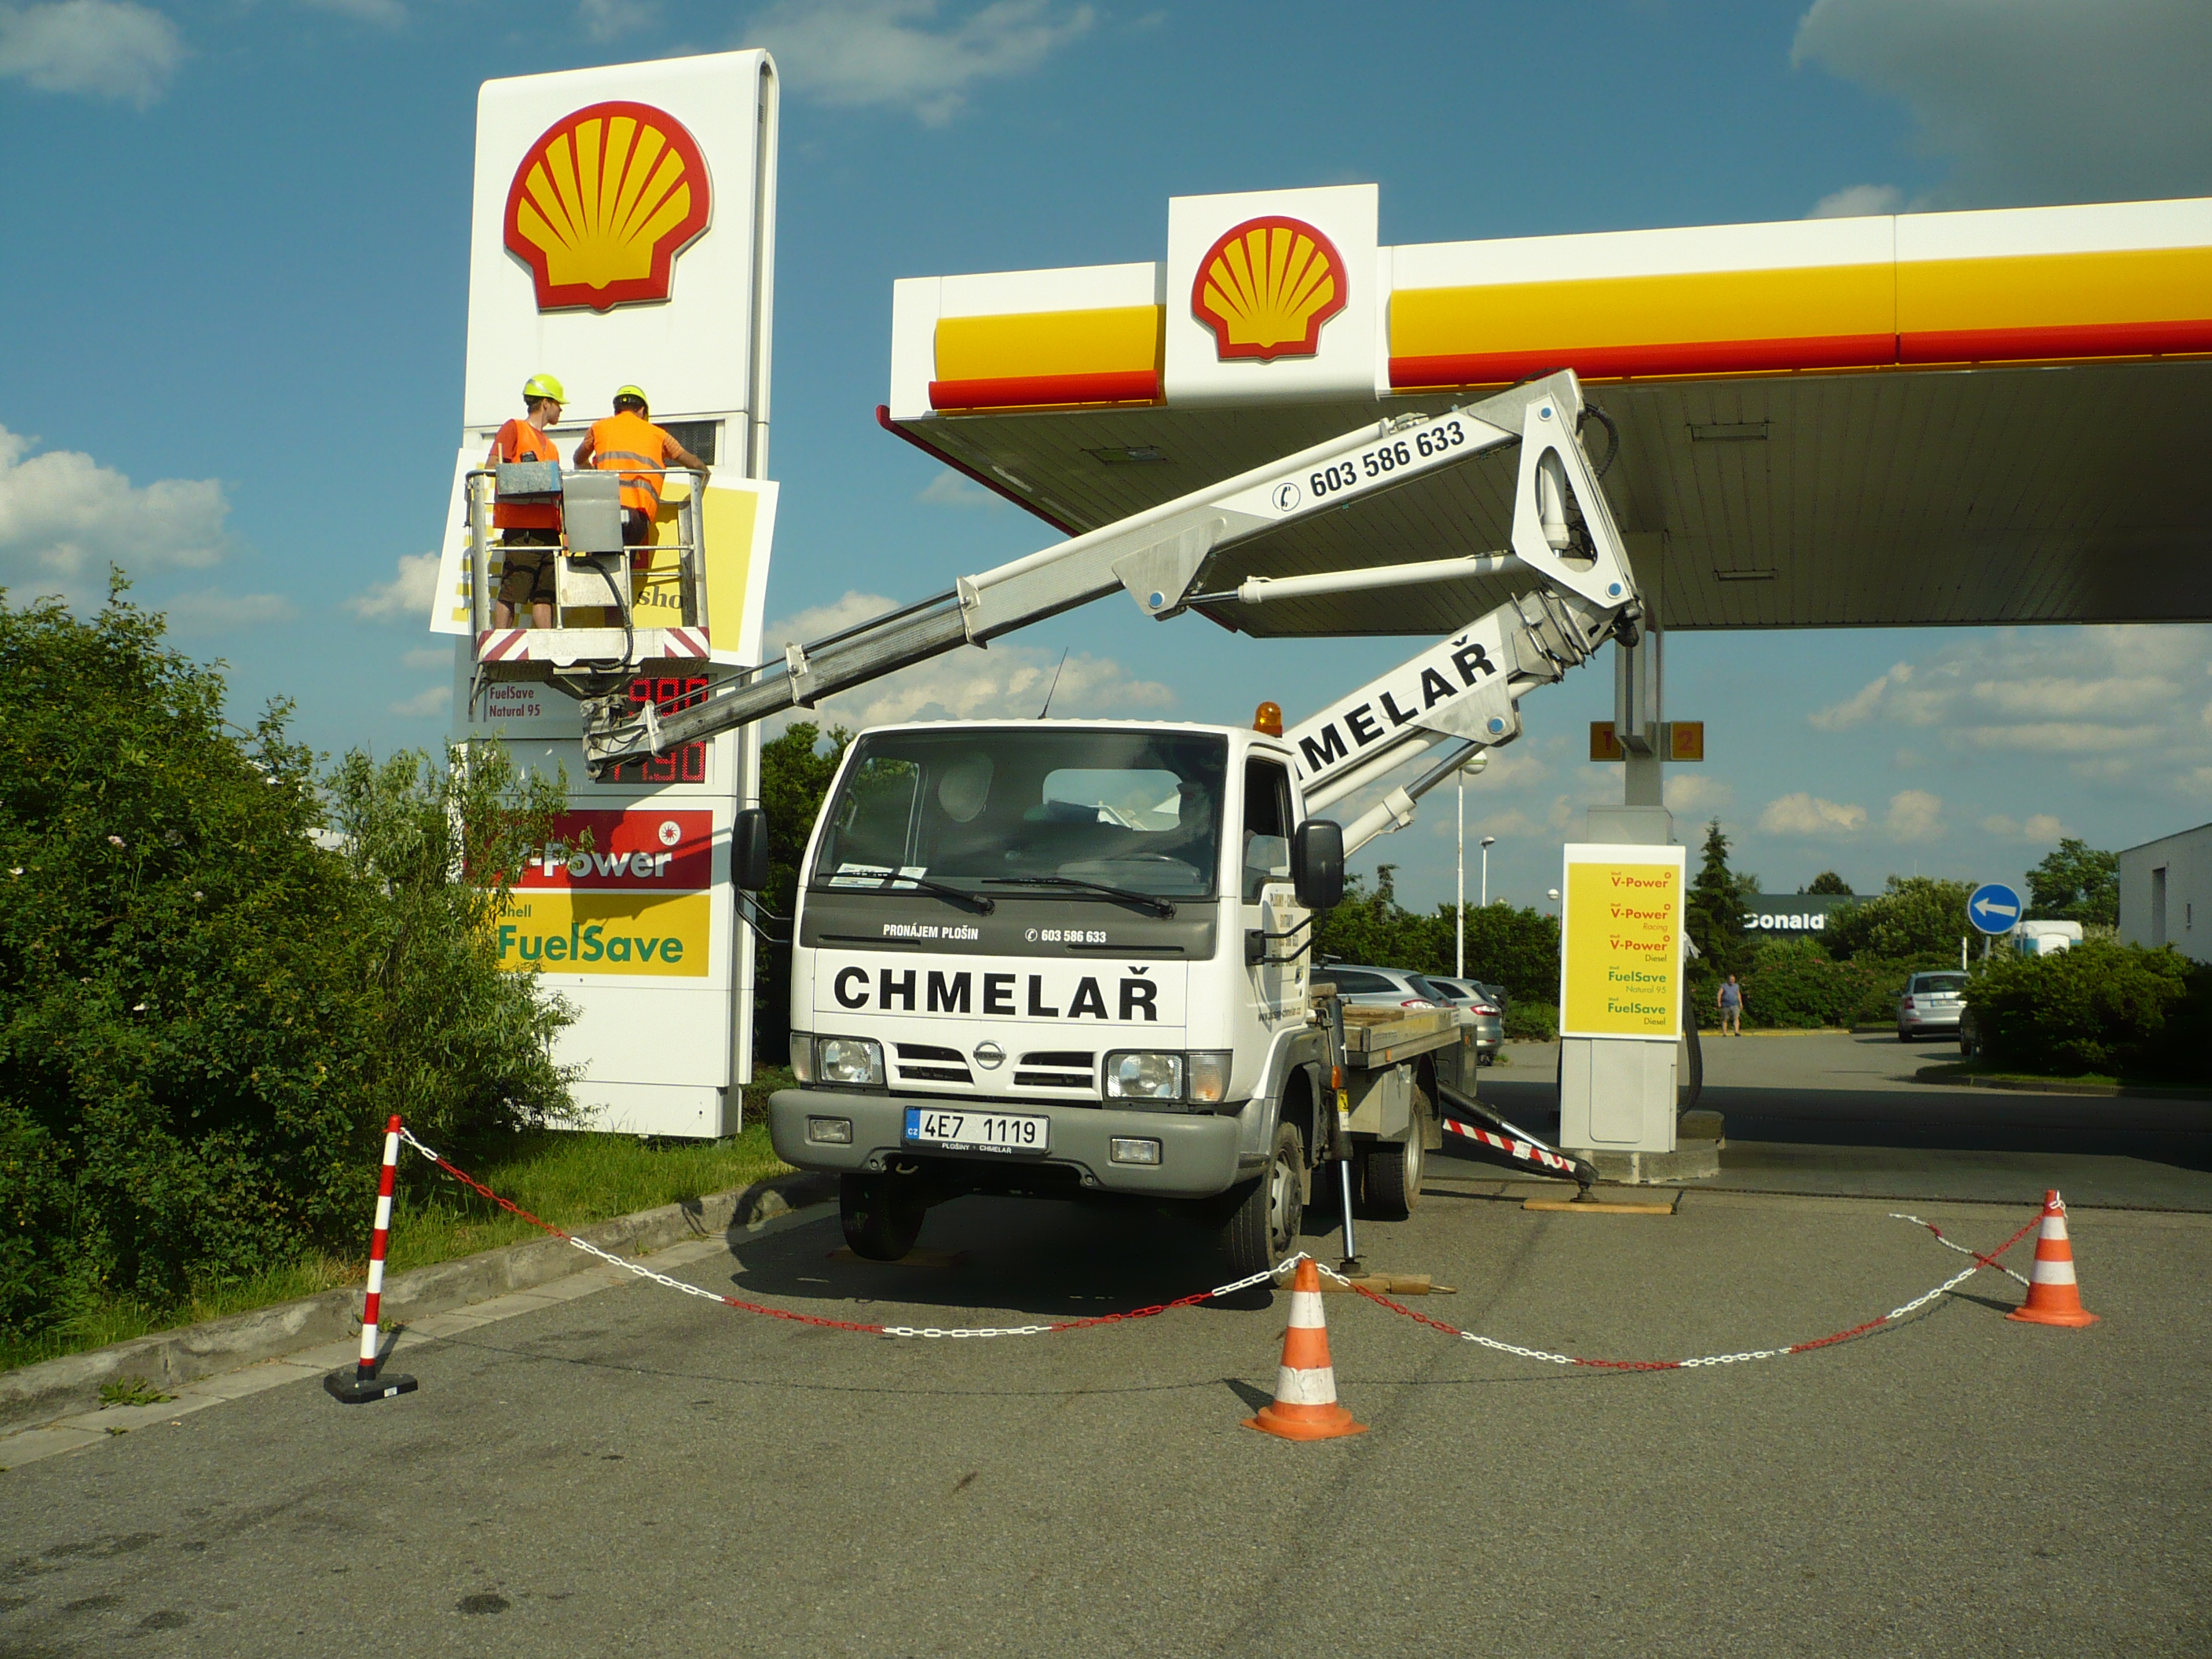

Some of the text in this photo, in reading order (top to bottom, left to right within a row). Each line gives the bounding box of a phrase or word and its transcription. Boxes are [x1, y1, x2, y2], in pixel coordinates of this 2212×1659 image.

[1310, 421, 1464, 496] 603 586 633
[636, 585, 683, 610] sho
[489, 685, 534, 699] FuelSave
[489, 705, 540, 717] Natural 95
[1295, 635, 1497, 782] MELAŘ
[1603, 731, 1613, 752] 1
[1678, 731, 1694, 752] 2
[507, 843, 672, 877] -Power
[1611, 877, 1668, 888] V-Power
[1611, 908, 1668, 919] V-Power
[883, 922, 979, 940] PRONÁJEM PLOŠIN
[1643, 922, 1668, 932] Racing
[499, 922, 683, 963] FuelSave
[1041, 929, 1107, 943] 603 586 633
[1610, 939, 1668, 951] V-Power
[1645, 954, 1667, 962] Diesel
[1609, 971, 1666, 983] FuelSave
[834, 965, 1158, 1021] CHMELAŘ
[1626, 985, 1654, 994] Natural
[1608, 1002, 1665, 1014] FuelSave
[925, 1114, 1035, 1144] 4E7 1119
